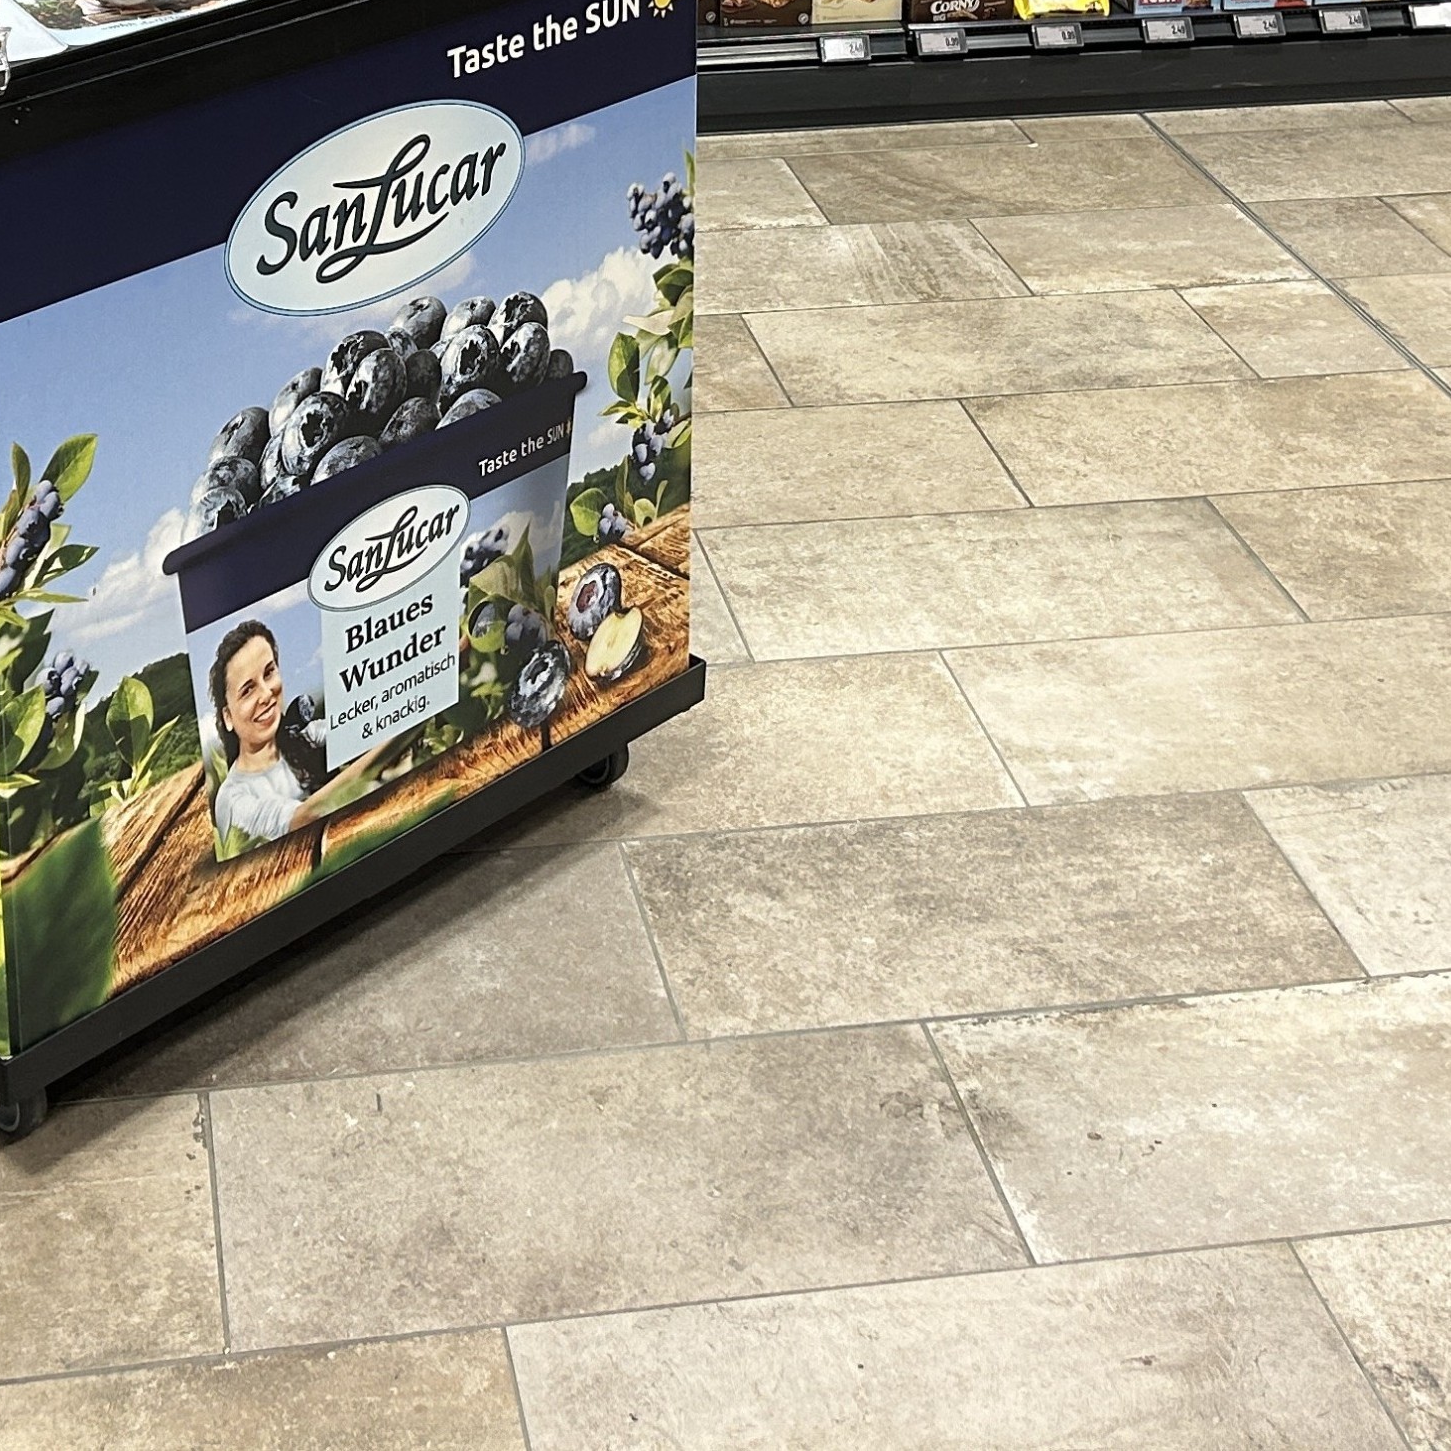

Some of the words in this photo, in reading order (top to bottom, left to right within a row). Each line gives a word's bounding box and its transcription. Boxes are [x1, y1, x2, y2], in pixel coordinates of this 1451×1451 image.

[448, 32, 524, 78] Taste
[532, 15, 578, 51] the
[256, 133, 507, 284] SanLucar
[478, 452, 517, 477] Taste
[520, 438, 545, 460] the
[546, 425, 565, 448] SUN
[324, 505, 460, 593] SanLucar
[344, 594, 433, 653] Blaues
[329, 697, 378, 732] Lecker,
[381, 653, 457, 706] aromatisch
[338, 625, 447, 694] Wunder
[361, 723, 373, 739] &
[375, 698, 431, 735] knackig.
